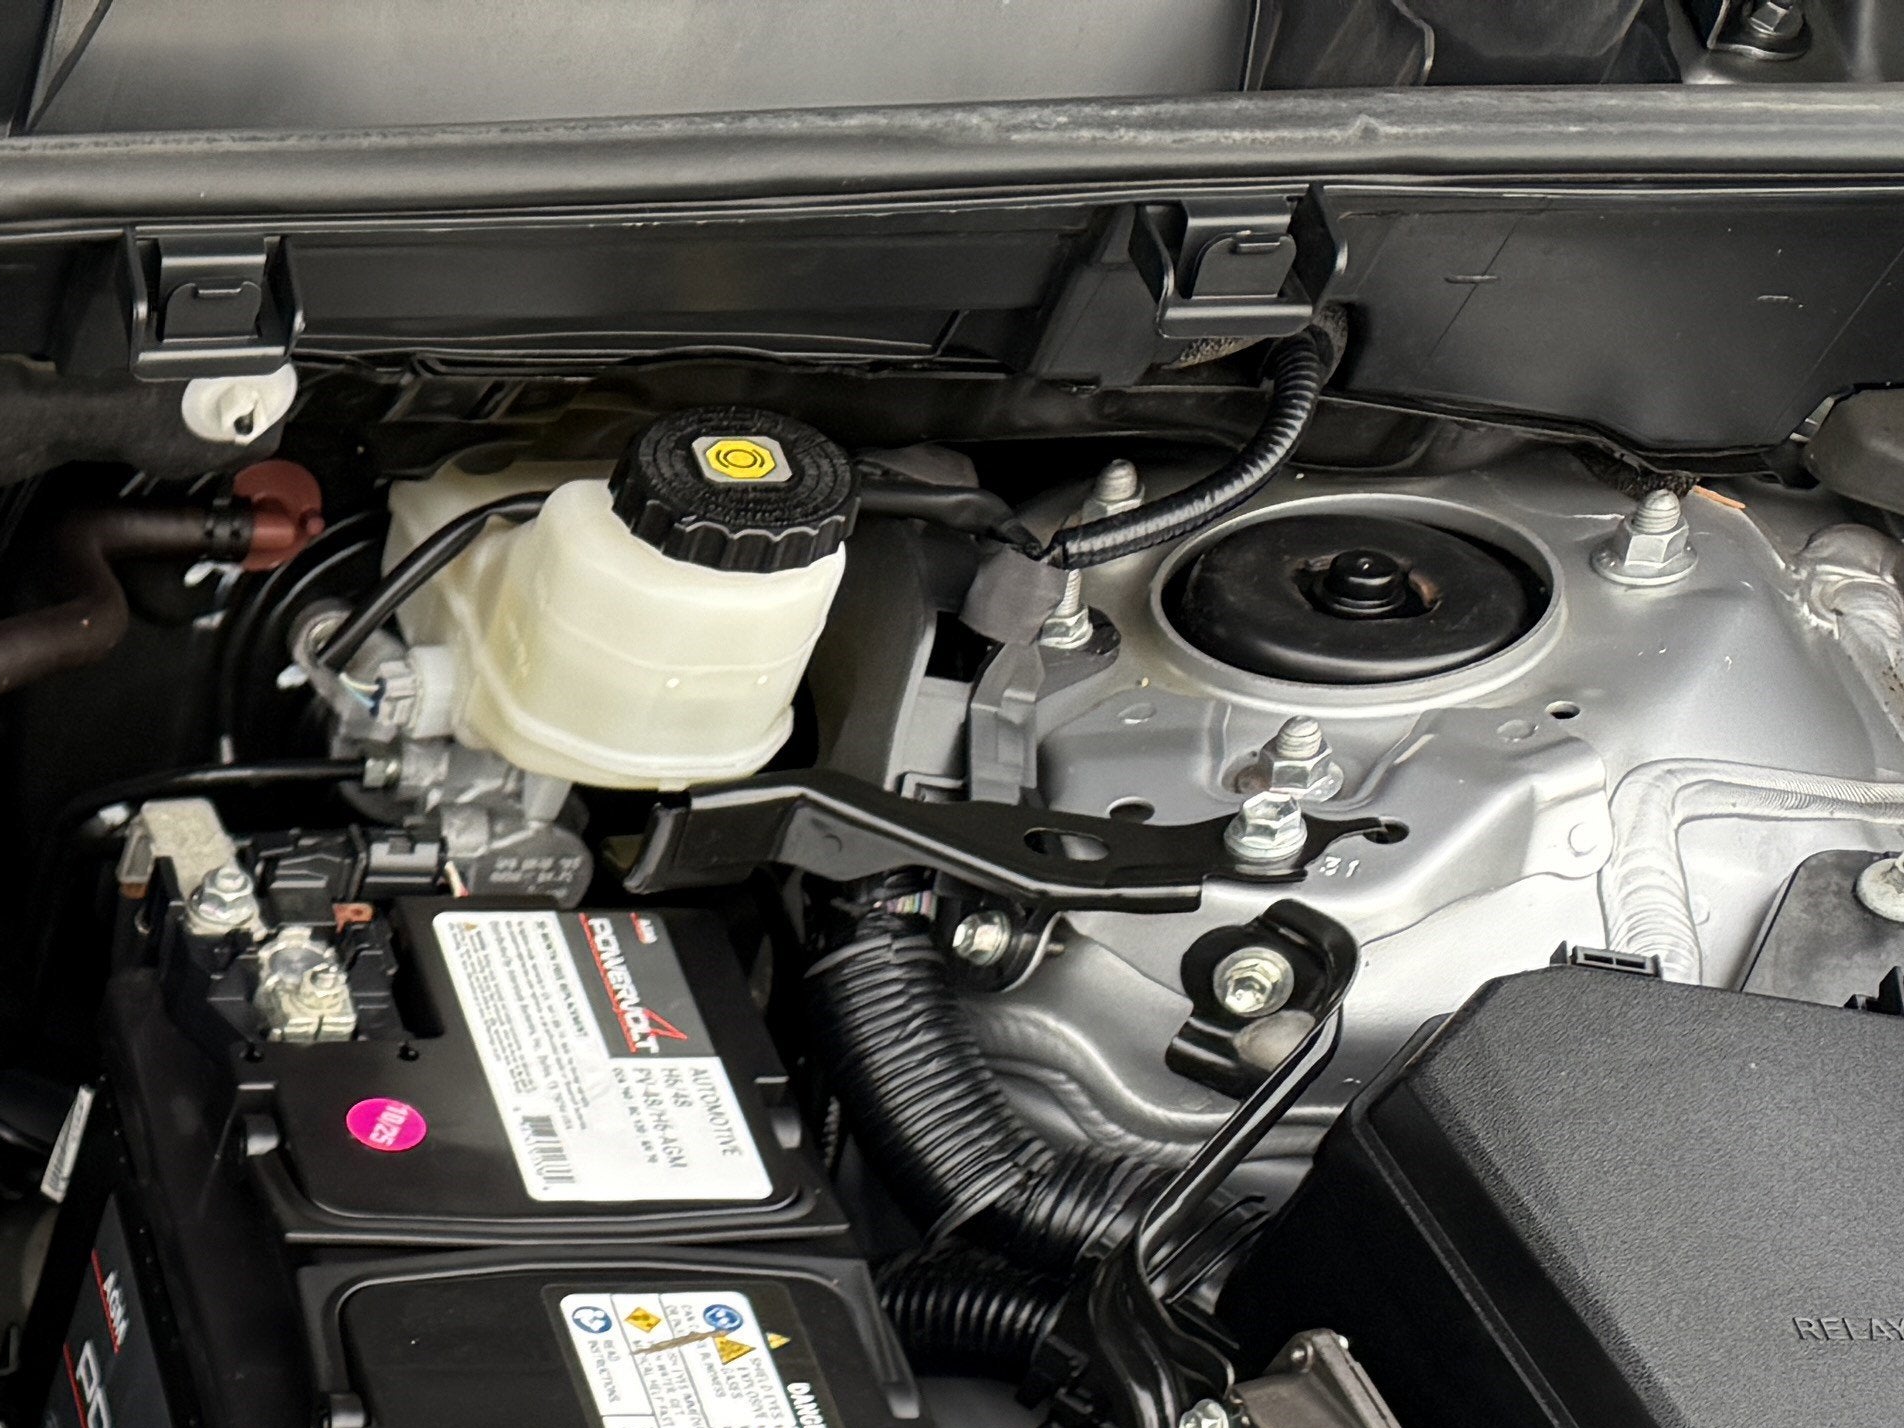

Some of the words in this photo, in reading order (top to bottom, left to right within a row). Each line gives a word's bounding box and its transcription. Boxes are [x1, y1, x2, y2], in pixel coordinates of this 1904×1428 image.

[585, 917, 661, 1054] POWERVOLT
[369, 1104, 410, 1148] 10/25
[687, 1067, 742, 1156] AUTOMOTIVE
[1792, 1317, 1904, 1341] RELAY
